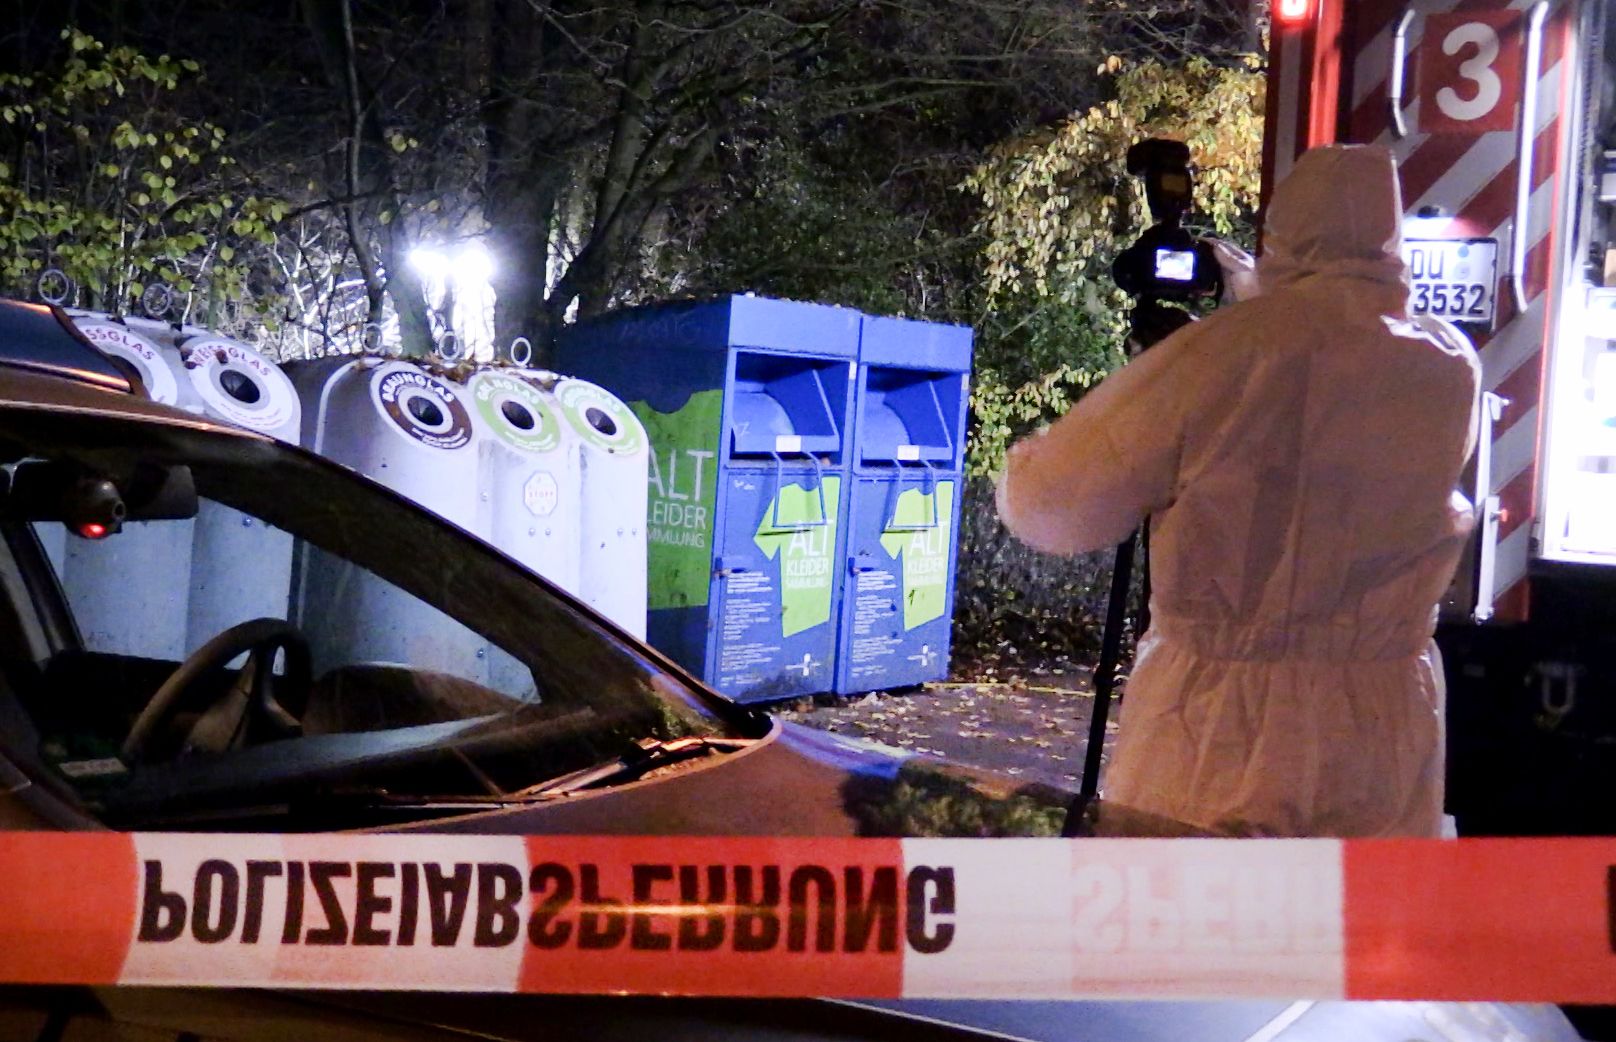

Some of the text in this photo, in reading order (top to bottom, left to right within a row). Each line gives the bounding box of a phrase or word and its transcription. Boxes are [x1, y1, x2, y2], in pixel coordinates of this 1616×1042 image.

[1436, 22, 1501, 120] 3
[1411, 249, 1444, 279] DU
[1413, 283, 1486, 316] 3532
[85, 328, 155, 360] SSGLAS
[648, 501, 706, 530] EIDER
[787, 518, 834, 557] ALT
[786, 556, 829, 577] KLEIDER
